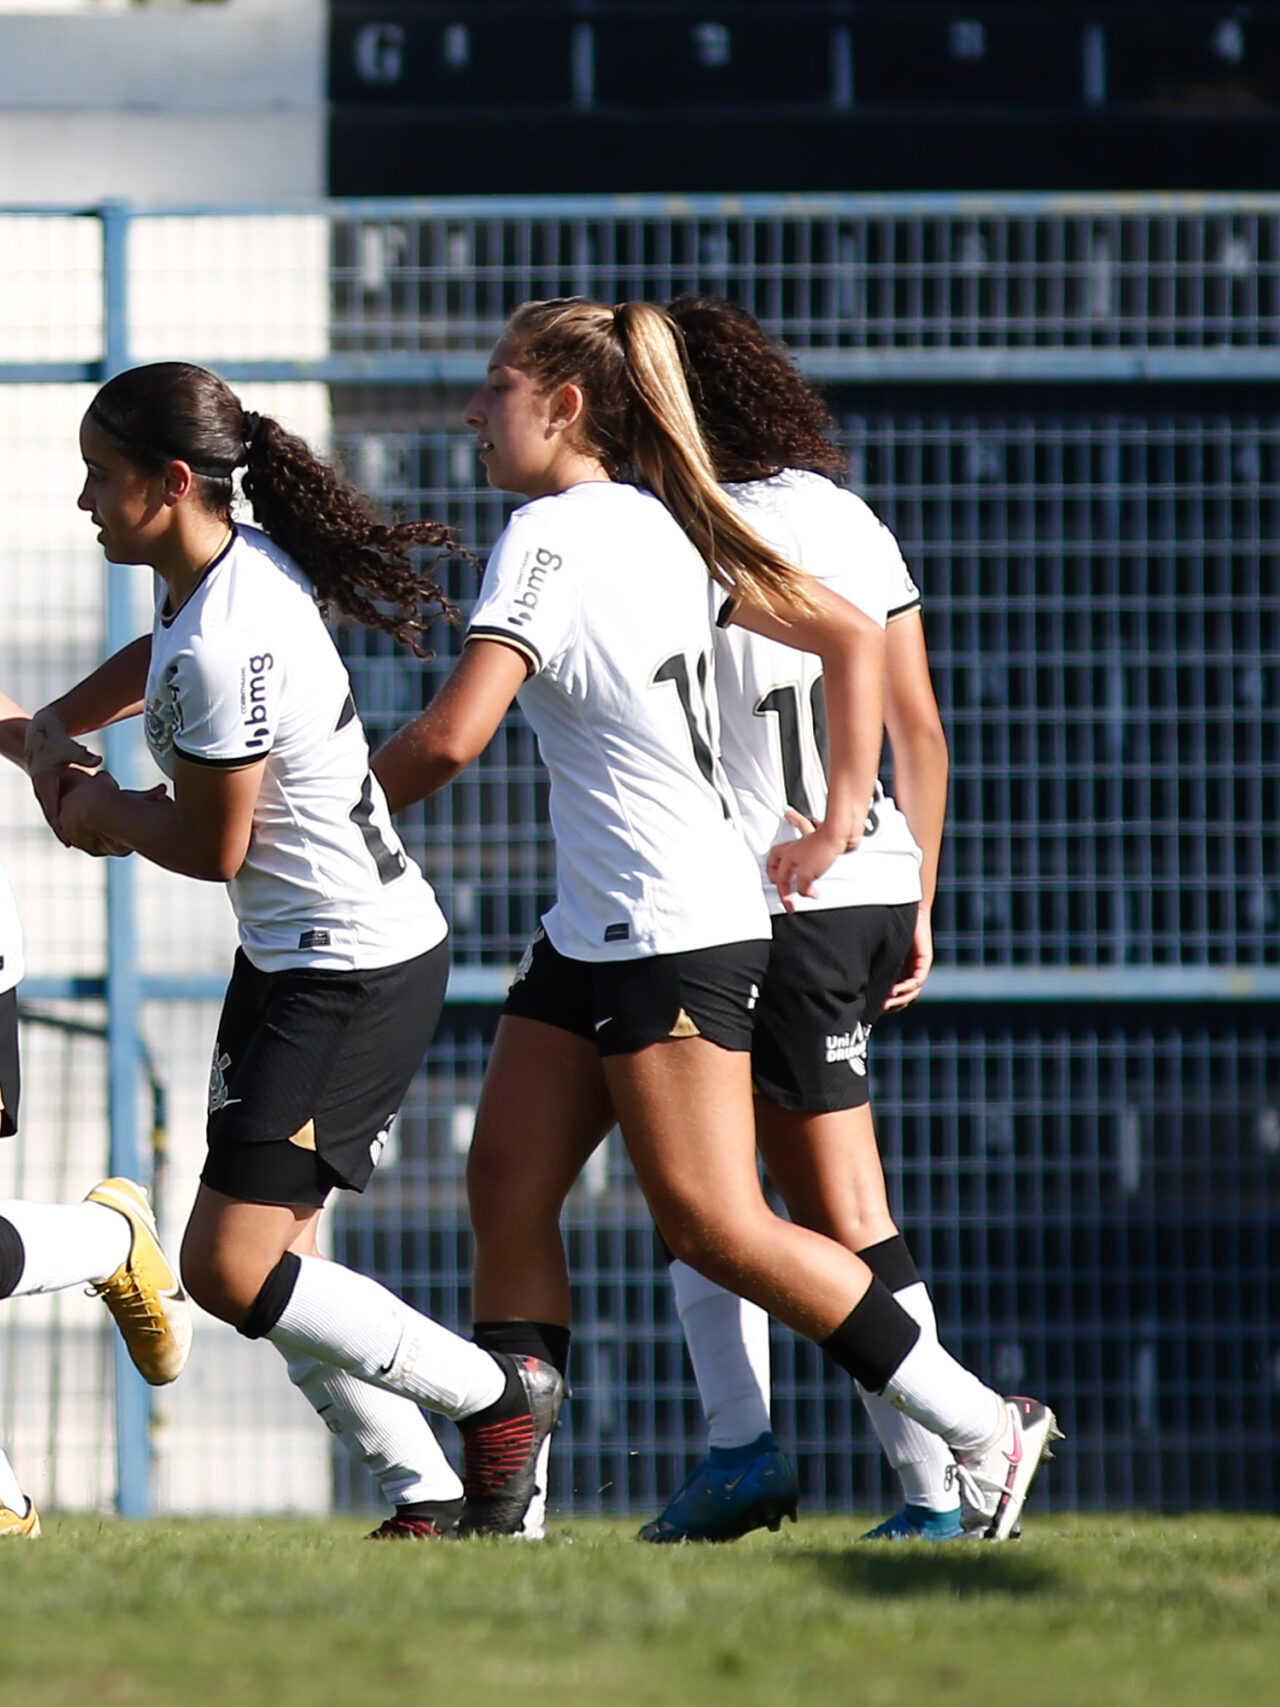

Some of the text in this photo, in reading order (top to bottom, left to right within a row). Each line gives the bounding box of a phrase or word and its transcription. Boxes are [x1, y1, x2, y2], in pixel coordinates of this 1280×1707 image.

[355, 22, 404, 83] G
[514, 547, 563, 610] bmg
[244, 653, 274, 726] bmg
[826, 1032, 850, 1050] Uni
